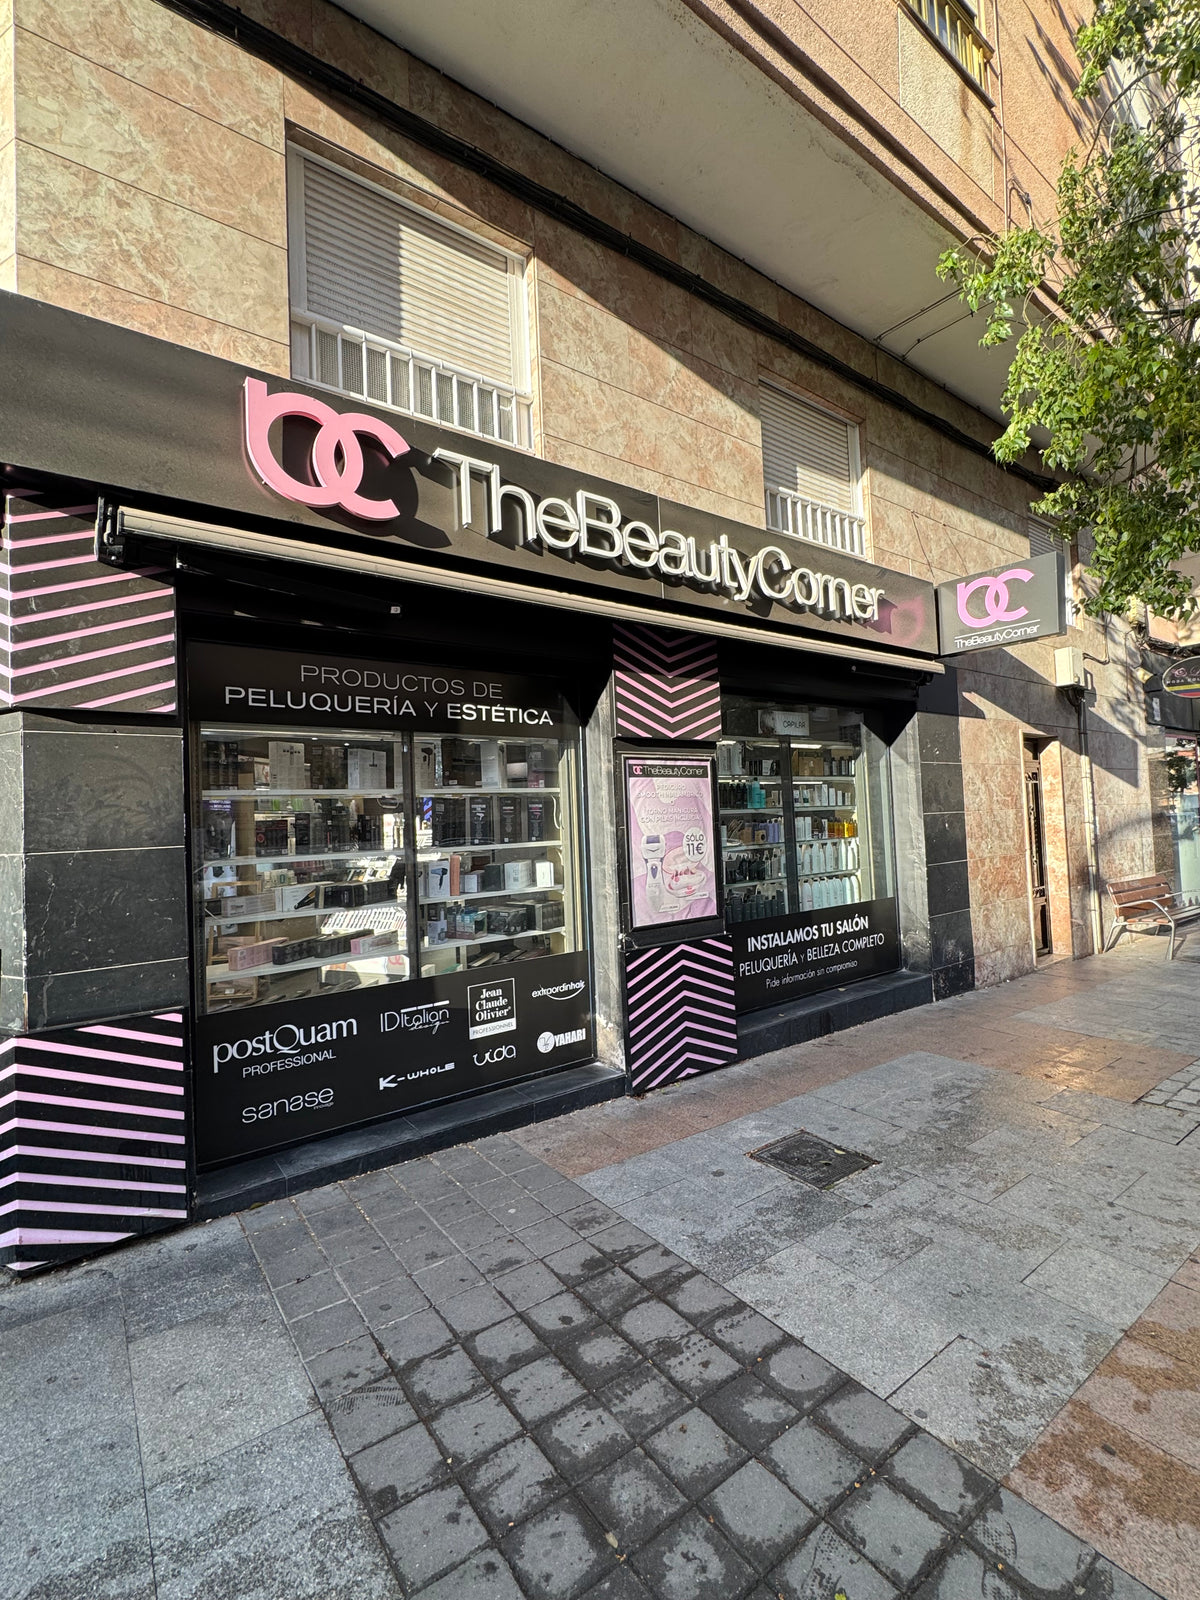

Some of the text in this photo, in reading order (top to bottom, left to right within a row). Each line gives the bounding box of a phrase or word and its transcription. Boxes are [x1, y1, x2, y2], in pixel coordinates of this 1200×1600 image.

[431, 447, 886, 623] TheBeautyCorner
[955, 624, 1041, 649] TheBeautyCorner
[300, 664, 504, 700] PRODUCTOS DE
[224, 685, 554, 726] PELUQUERÍA Y ESTÉTICA
[782, 720, 806, 729] CAPILAR
[643, 765, 704, 777] TheBeautyCorner
[686, 842, 704, 856] 11€
[747, 913, 869, 953] INSTALAMOS TU SALÓN
[739, 932, 885, 977] PELUQUERÍA Y BELLEZA COMPLETO
[765, 960, 858, 989] Pide información sin compromiso
[475, 997, 508, 1011] Claude
[480, 988, 503, 999] Jean
[472, 1022, 514, 1036] PROFESSIONNEL
[554, 1028, 587, 1047] YAHARI
[212, 1018, 357, 1074] postQuam
[242, 1049, 337, 1079] PROFESSIONAL
[241, 1087, 335, 1124] sanase
